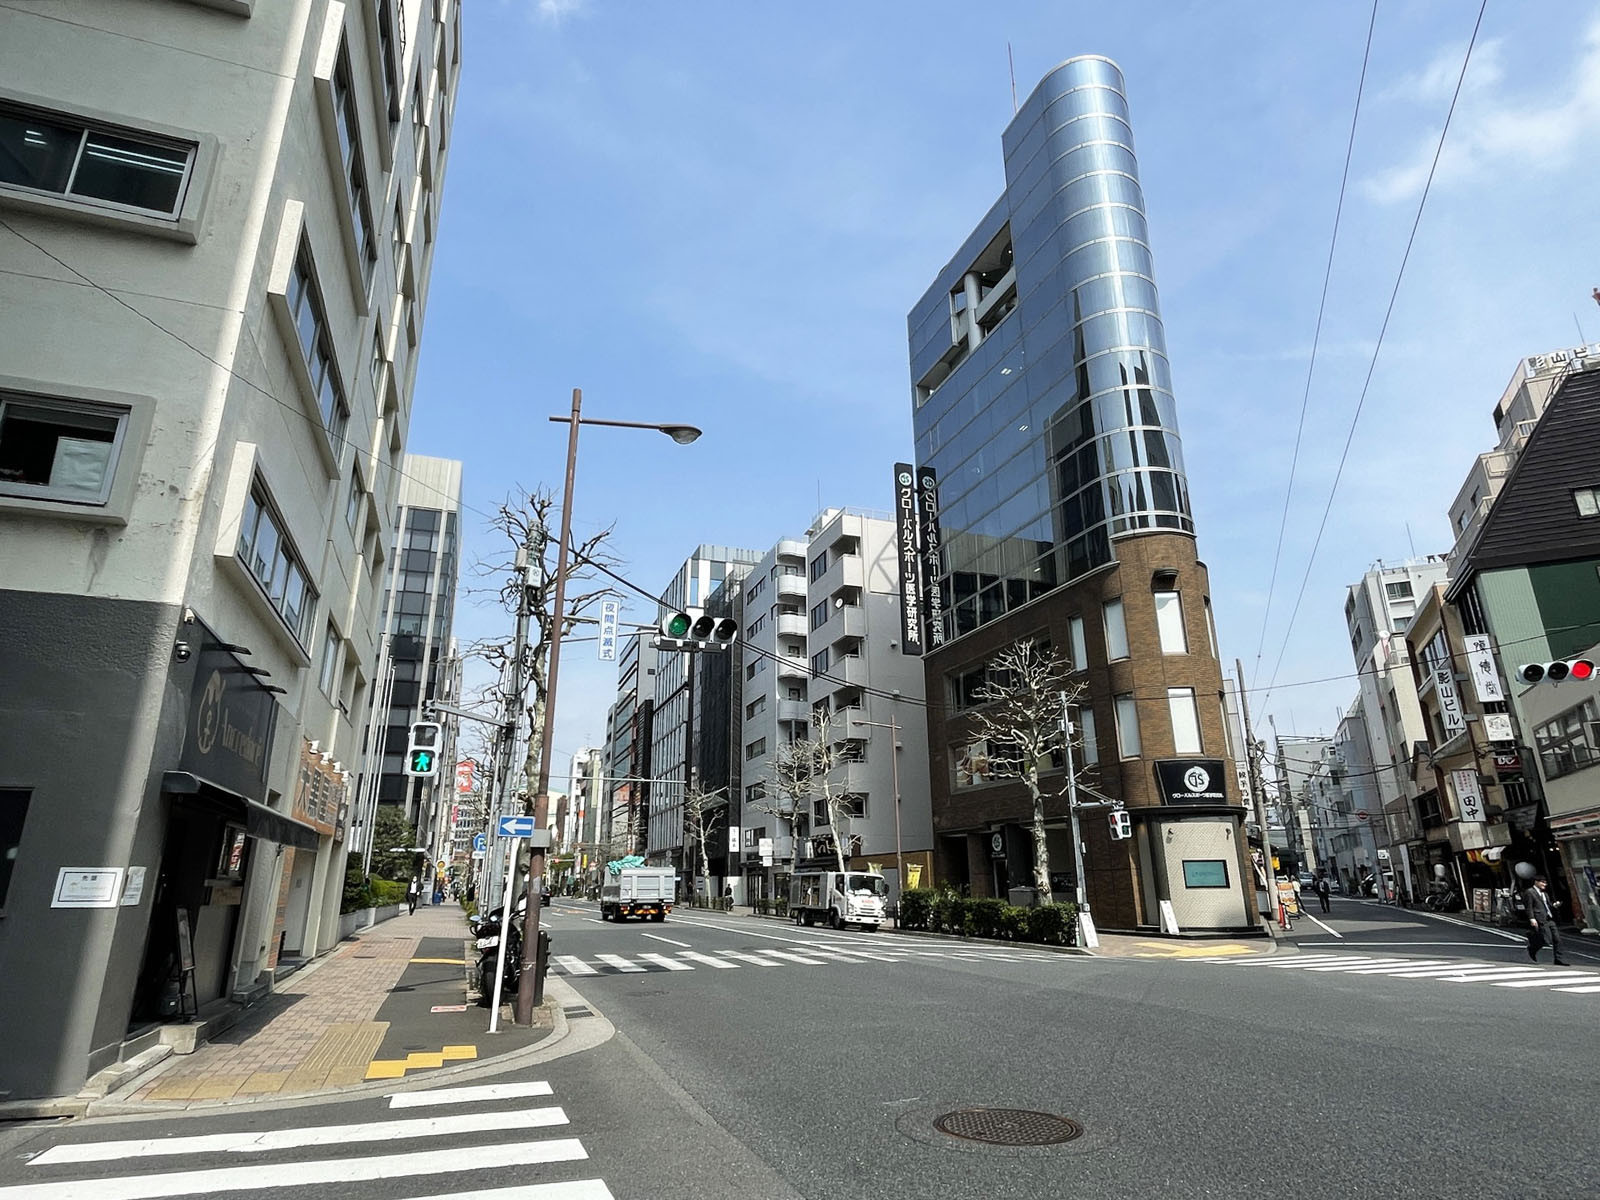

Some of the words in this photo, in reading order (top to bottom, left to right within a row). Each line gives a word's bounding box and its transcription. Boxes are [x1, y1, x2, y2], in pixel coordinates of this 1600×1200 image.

[1528, 344, 1600, 368] 影山ビ
[603, 603, 615, 658] 夜間点滅式
[1437, 672, 1460, 726] 影山ビル
[1463, 795, 1479, 820] 田中
